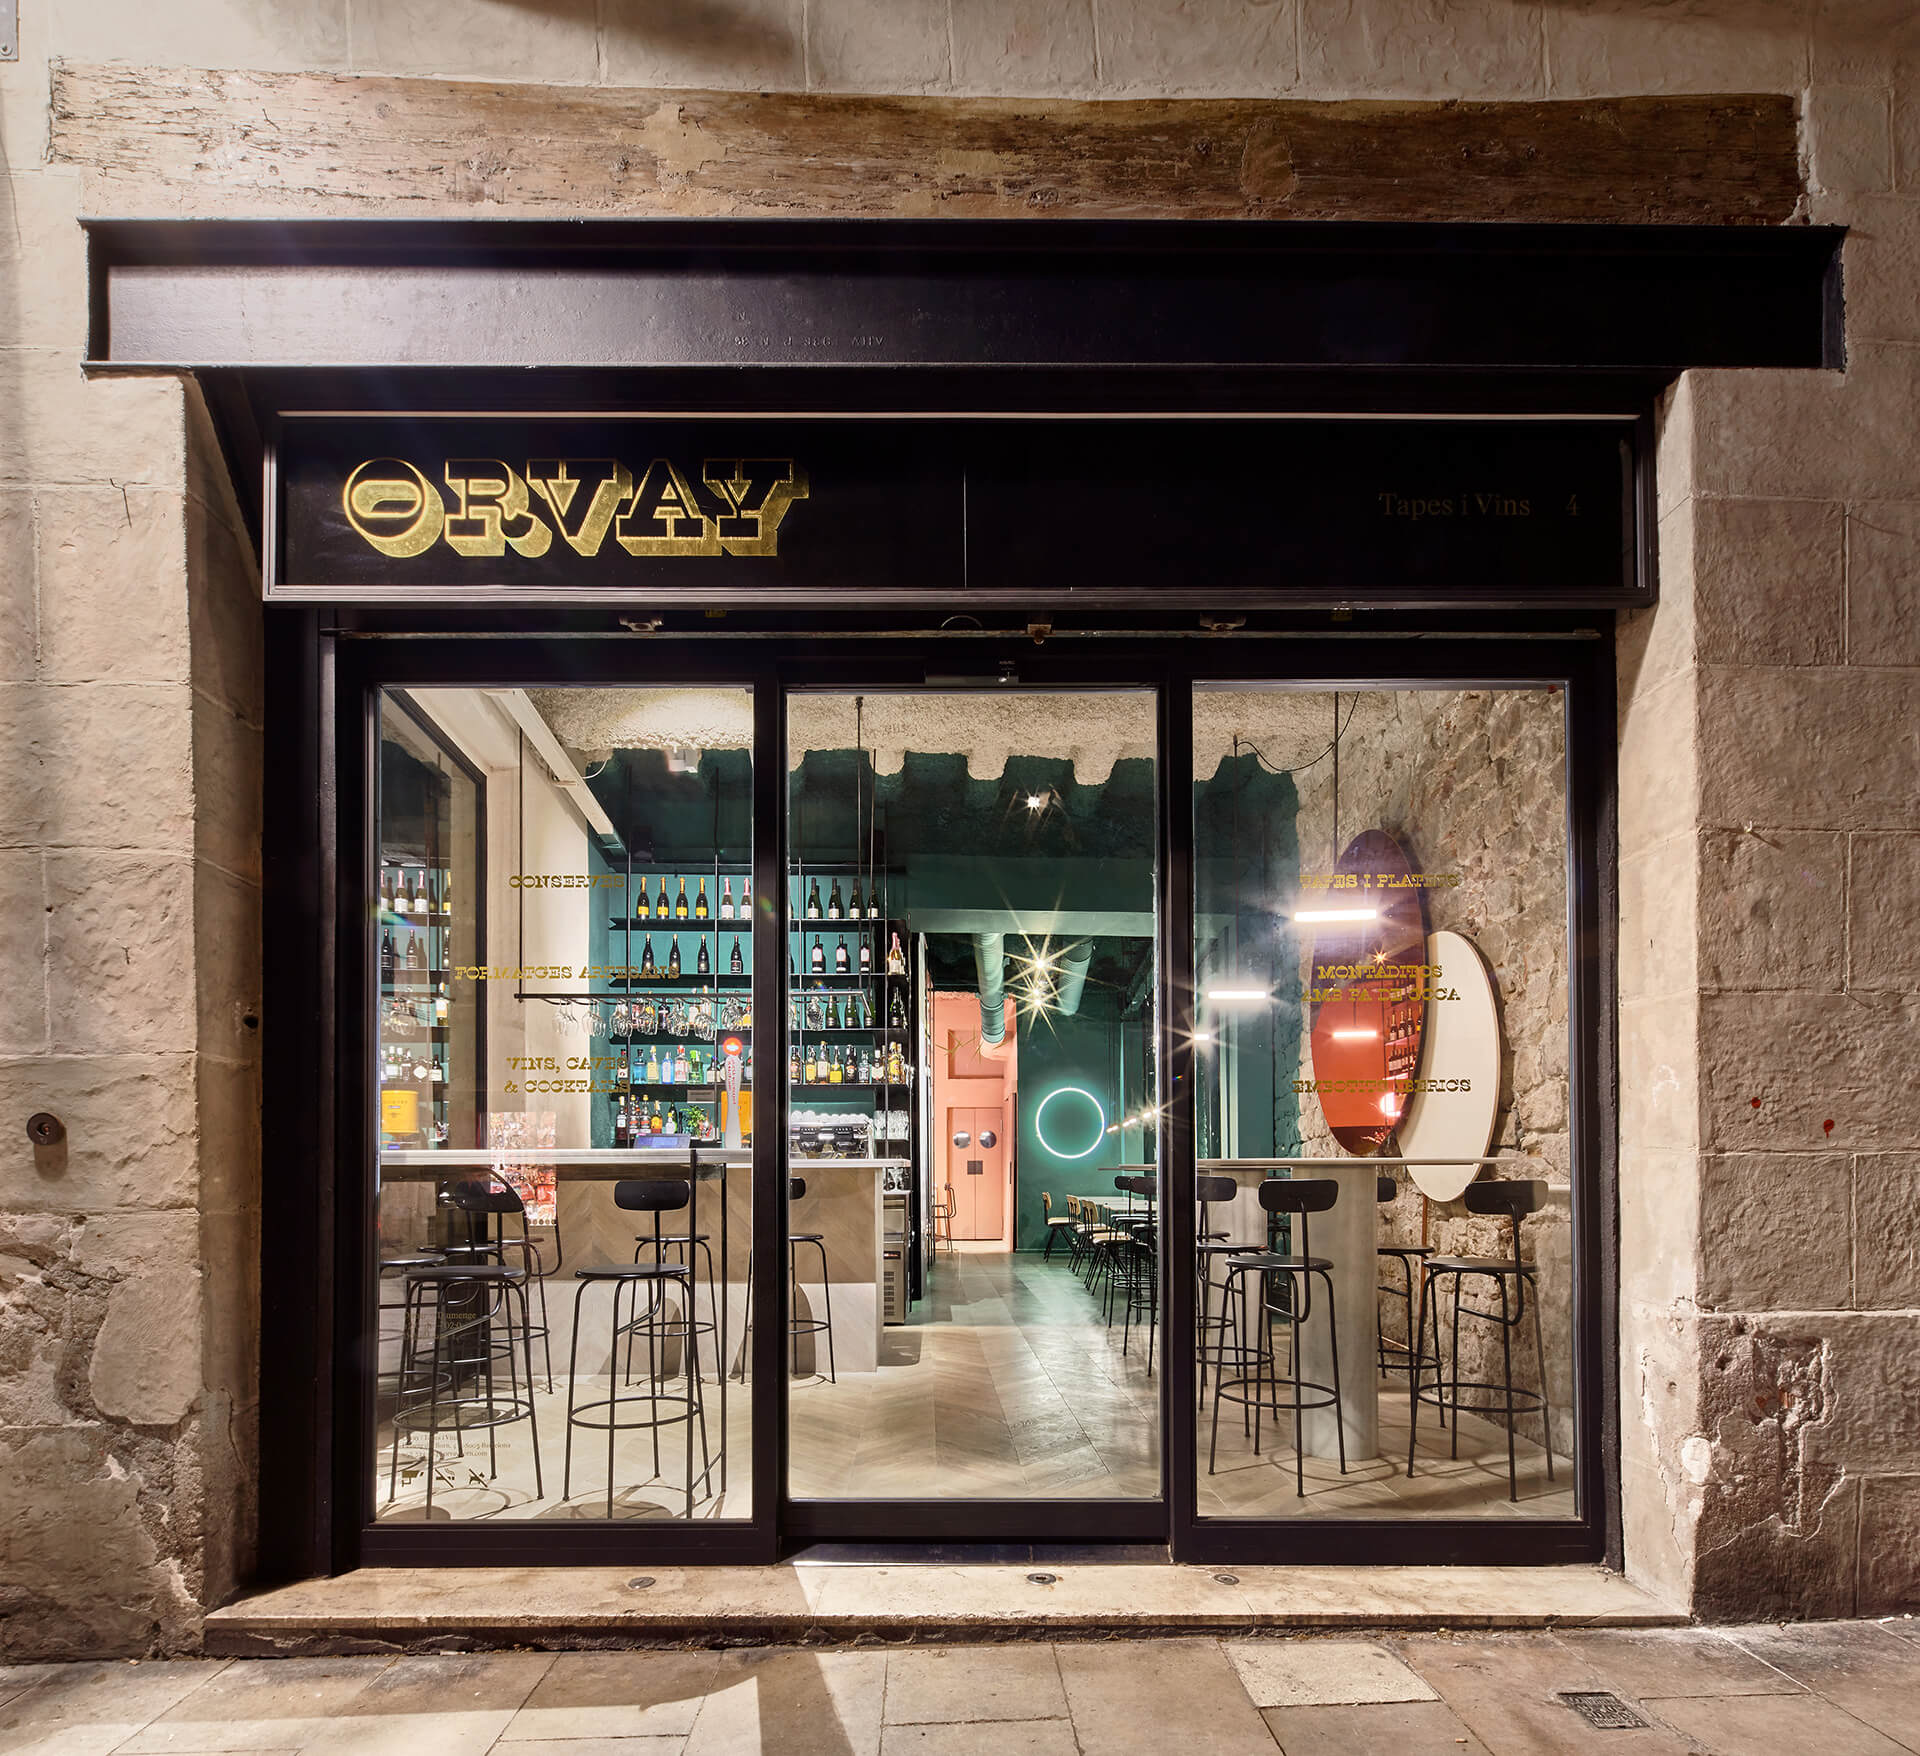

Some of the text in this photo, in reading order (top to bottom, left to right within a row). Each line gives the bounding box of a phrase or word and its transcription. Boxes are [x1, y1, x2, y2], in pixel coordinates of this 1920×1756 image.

[345, 457, 810, 558] ORVAY
[1377, 492, 1579, 520] Tapes i Vins 4
[508, 875, 625, 889] CONSERVES
[1299, 874, 1358, 889] TAPES
[1363, 874, 1372, 888] I
[454, 966, 573, 980] FORMATGES
[1317, 965, 1443, 980] MONTADITOS
[1301, 987, 1461, 1001] AMB PA DE COCA
[506, 1056, 628, 1074] VINS, CAVES
[503, 1080, 631, 1094] & COCKTAILS
